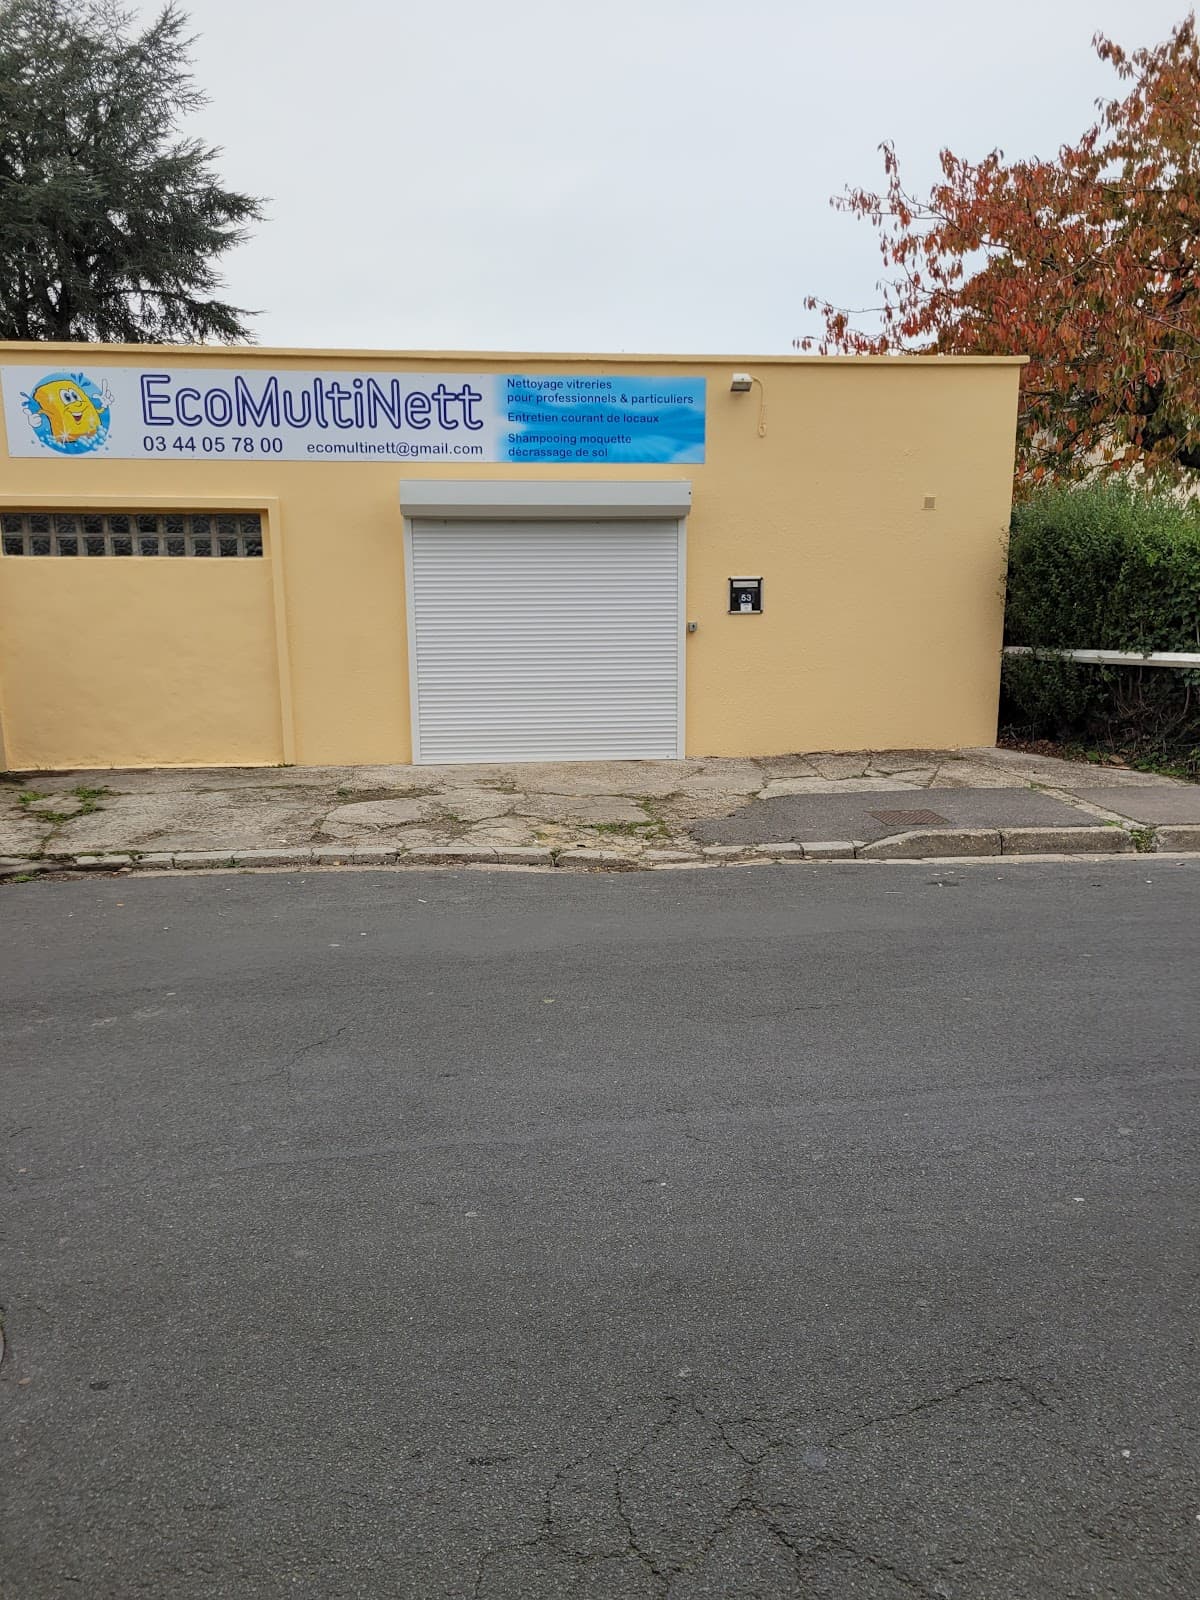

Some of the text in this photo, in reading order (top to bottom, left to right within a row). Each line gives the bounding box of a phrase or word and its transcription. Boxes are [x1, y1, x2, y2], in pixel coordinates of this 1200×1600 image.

[507, 378, 612, 391] Nettoyage vitreries
[140, 373, 484, 431] EcoMultiNett
[507, 393, 694, 406] pour professionnels & particuliers
[508, 412, 660, 423] Entretien courant de locaux
[143, 436, 283, 454] 03 44 05 78 00
[508, 433, 632, 445] Shampooing moquette
[307, 441, 483, 457] ecomultinett@gmail.com
[508, 447, 608, 459] décrassage de sol
